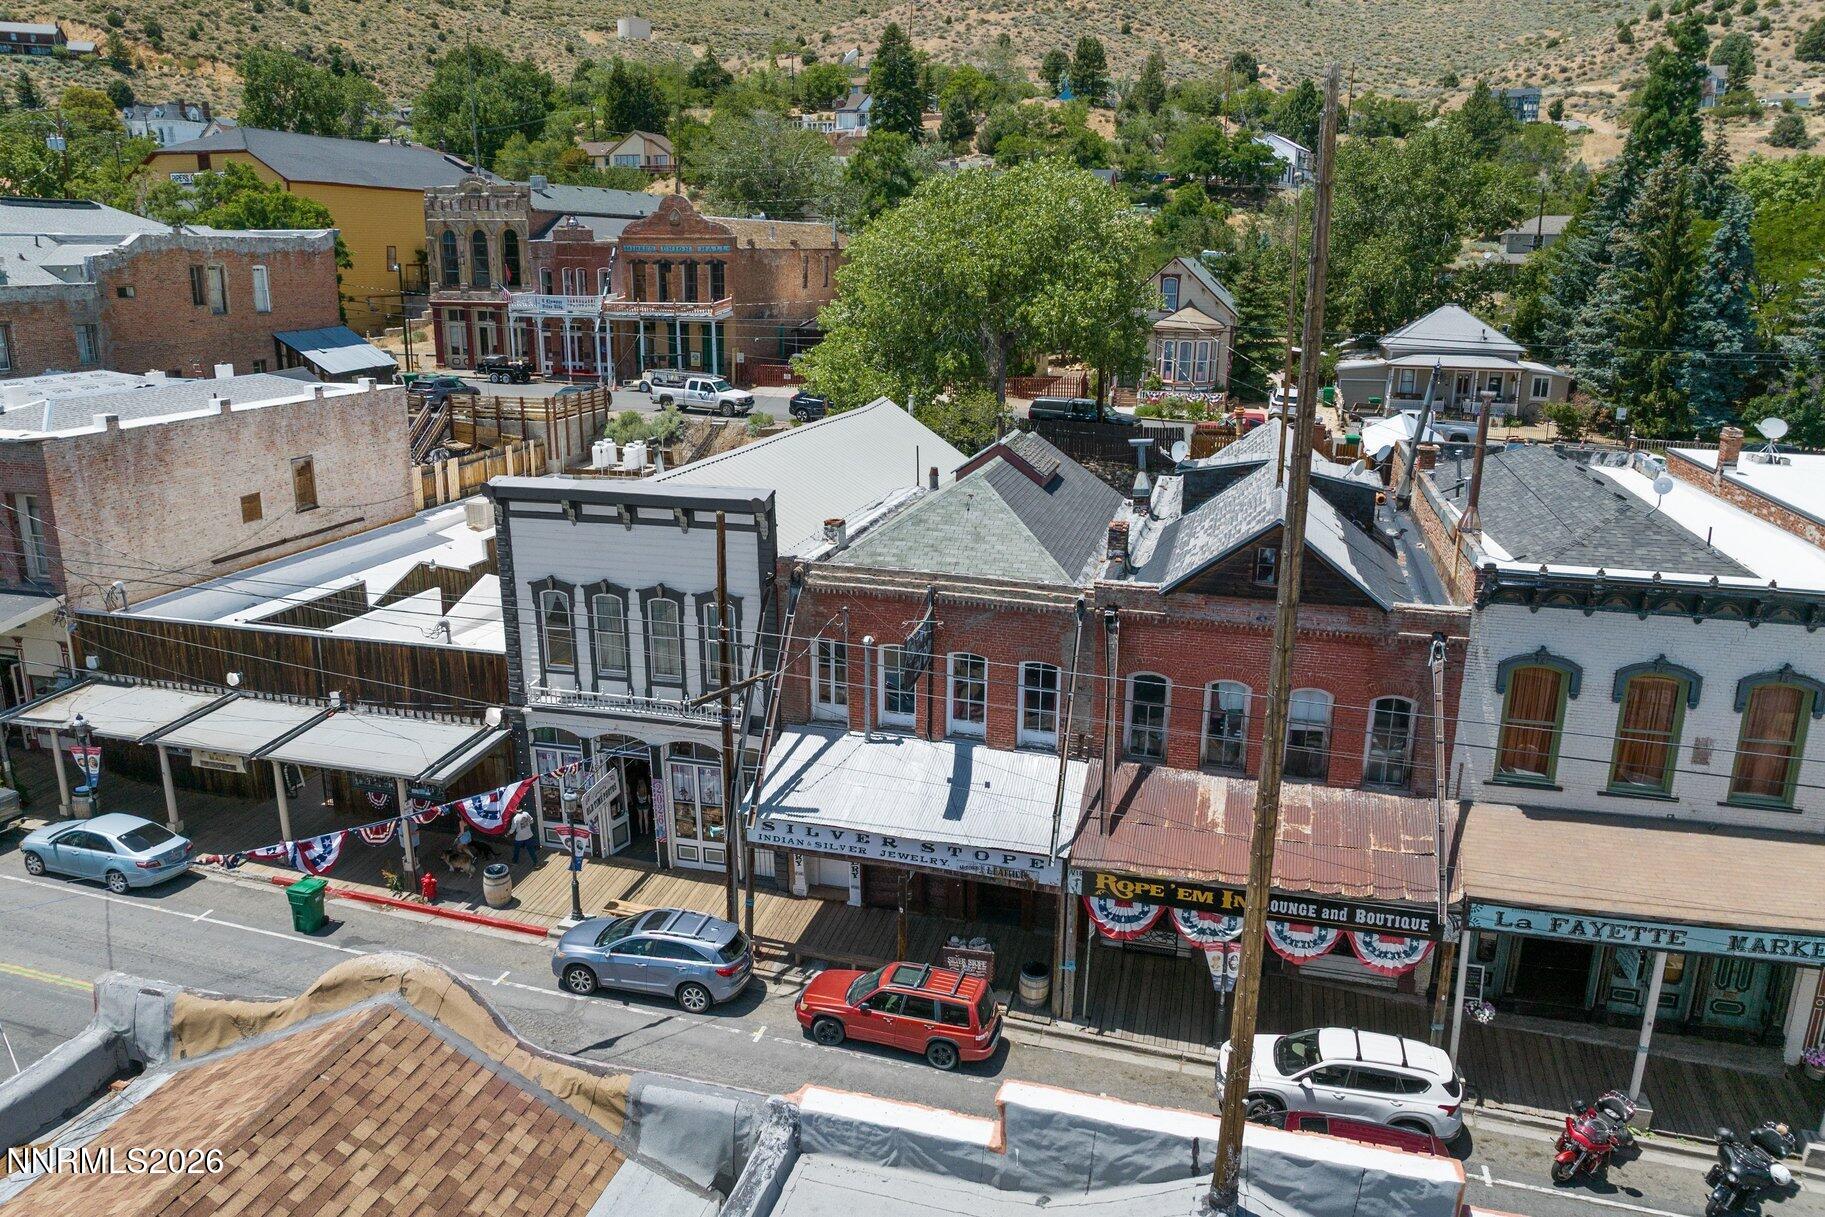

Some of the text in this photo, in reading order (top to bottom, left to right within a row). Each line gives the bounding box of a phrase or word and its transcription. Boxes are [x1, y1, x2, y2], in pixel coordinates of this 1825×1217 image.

[758, 833, 804, 846] INDIAN
[814, 841, 868, 855] SILVER
[762, 821, 898, 849] SILVER
[921, 842, 1045, 870] STOPE
[1267, 900, 1317, 917] OUNGE
[1321, 907, 1348, 922] and
[1354, 908, 1430, 931] BOUTIQUE
[1495, 911, 1533, 929] La
[1549, 917, 1688, 947] FAYETTE
